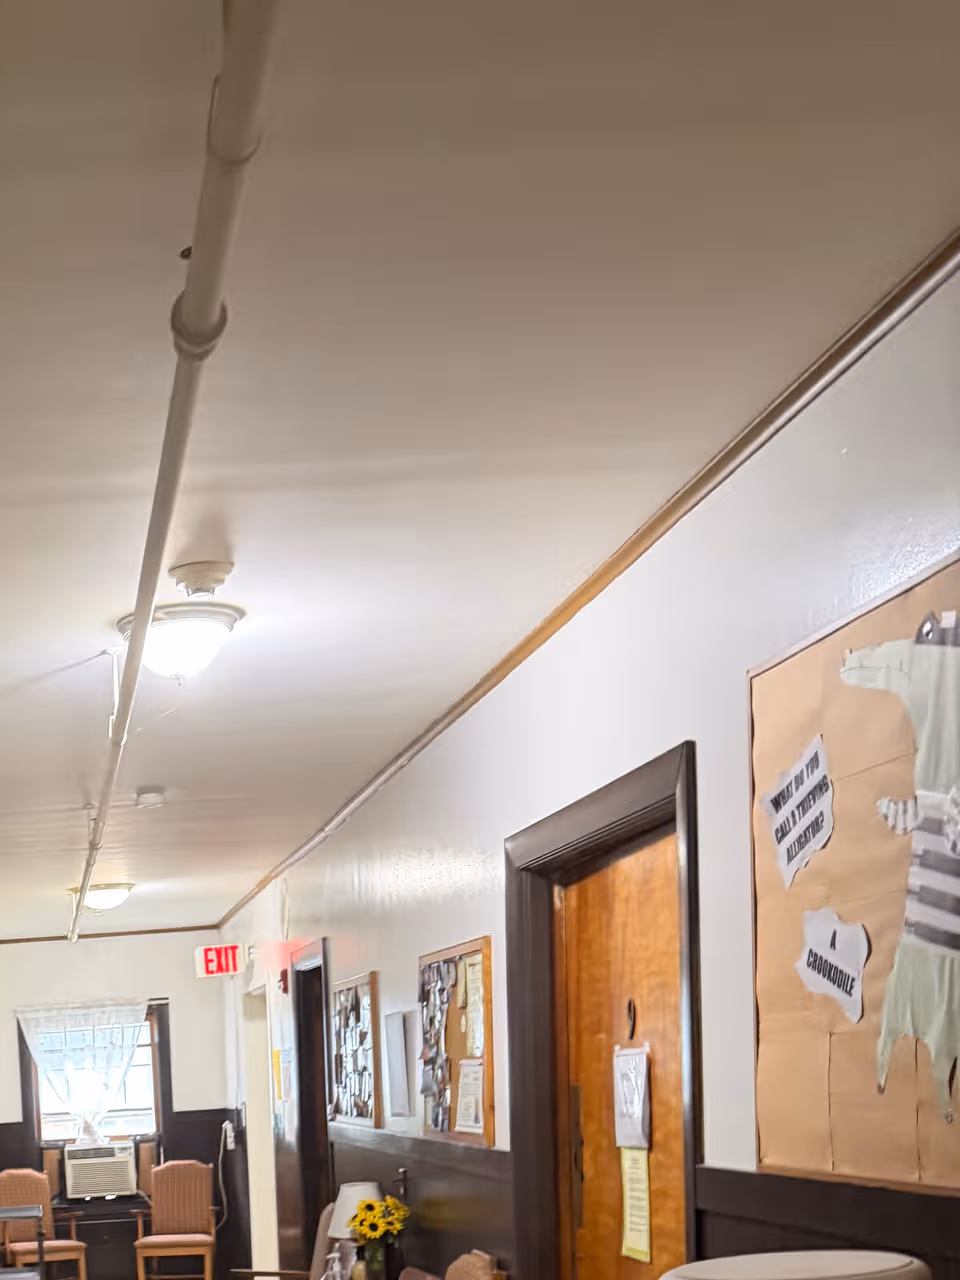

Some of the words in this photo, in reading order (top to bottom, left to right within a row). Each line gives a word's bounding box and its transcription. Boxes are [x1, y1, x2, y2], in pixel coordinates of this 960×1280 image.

[770, 778, 794, 815] WHAT
[794, 768, 805, 793] DO
[805, 750, 820, 779] YOU
[774, 815, 793, 845] CALL
[791, 809, 798, 830] A
[796, 773, 830, 822] THIEVING
[786, 810, 825, 866] ALLIGATOR?
[203, 945, 239, 975] EXIT
[829, 928, 837, 951] A
[806, 948, 856, 998] CROOKODILE
